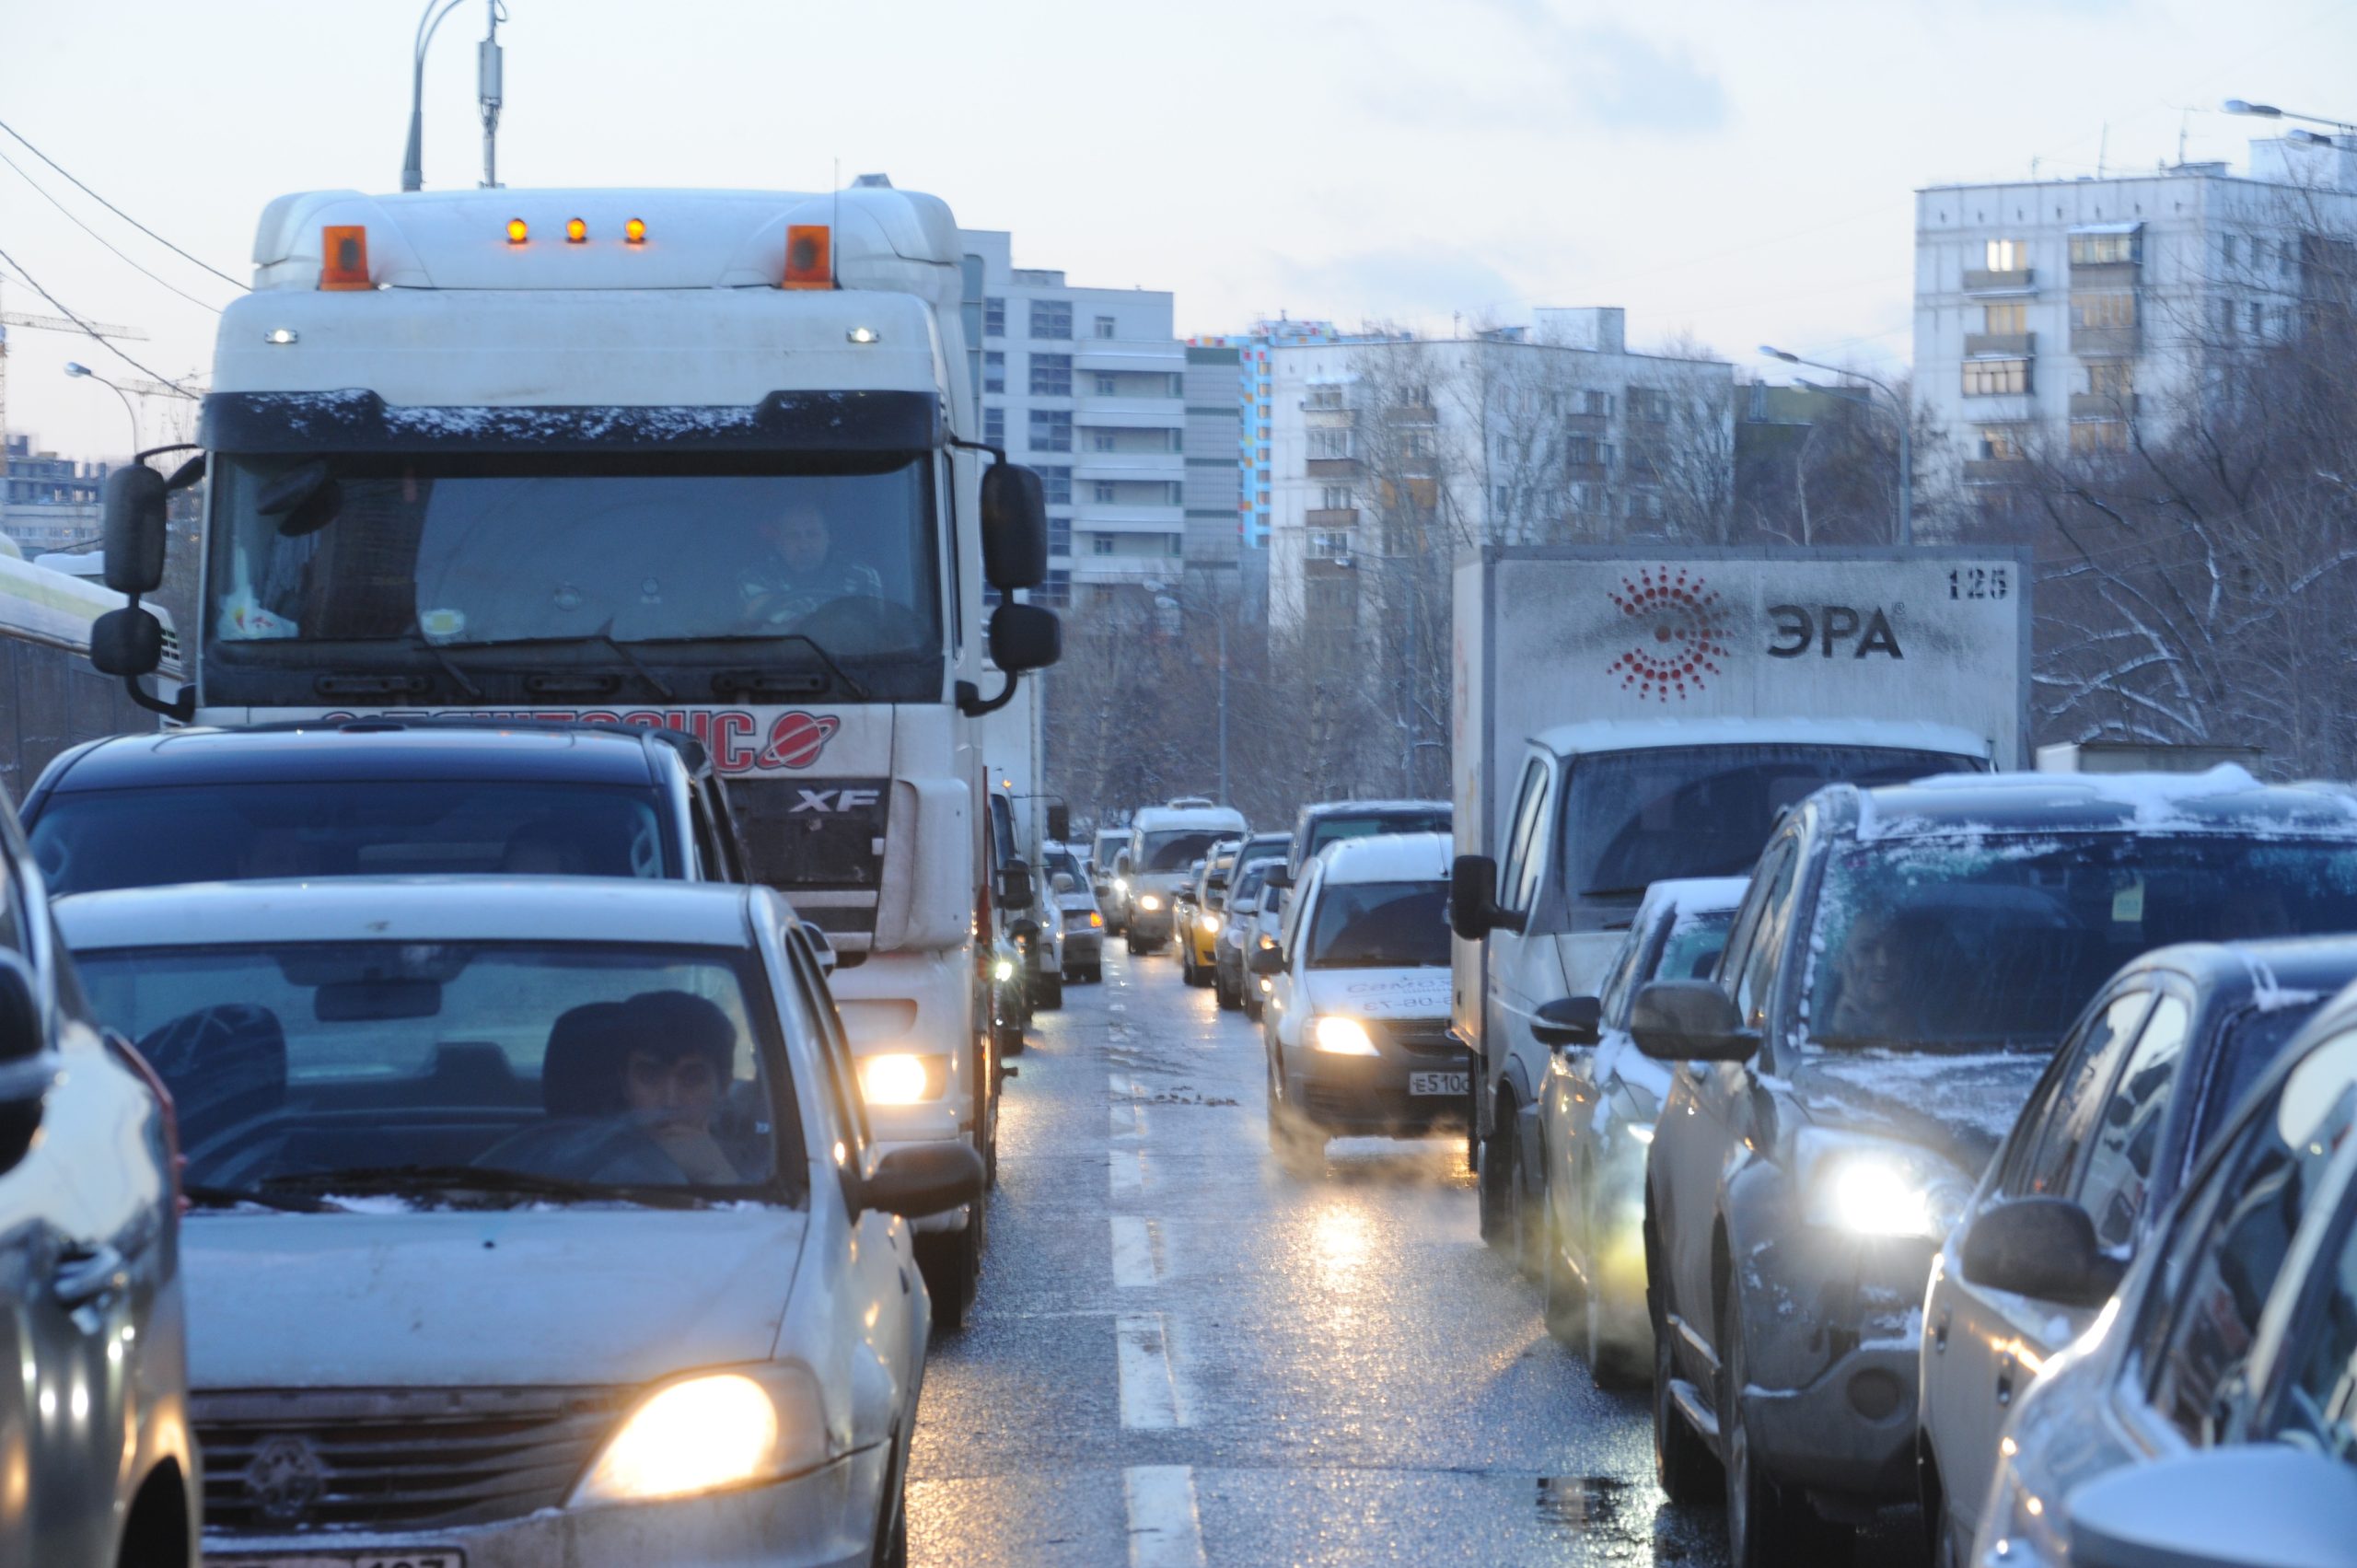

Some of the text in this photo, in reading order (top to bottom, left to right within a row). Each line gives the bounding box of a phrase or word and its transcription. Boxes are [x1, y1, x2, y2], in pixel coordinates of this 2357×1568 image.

[1949, 567, 2007, 599] 125
[1767, 604, 1904, 659] ЭРА
[789, 789, 879, 812] XF
